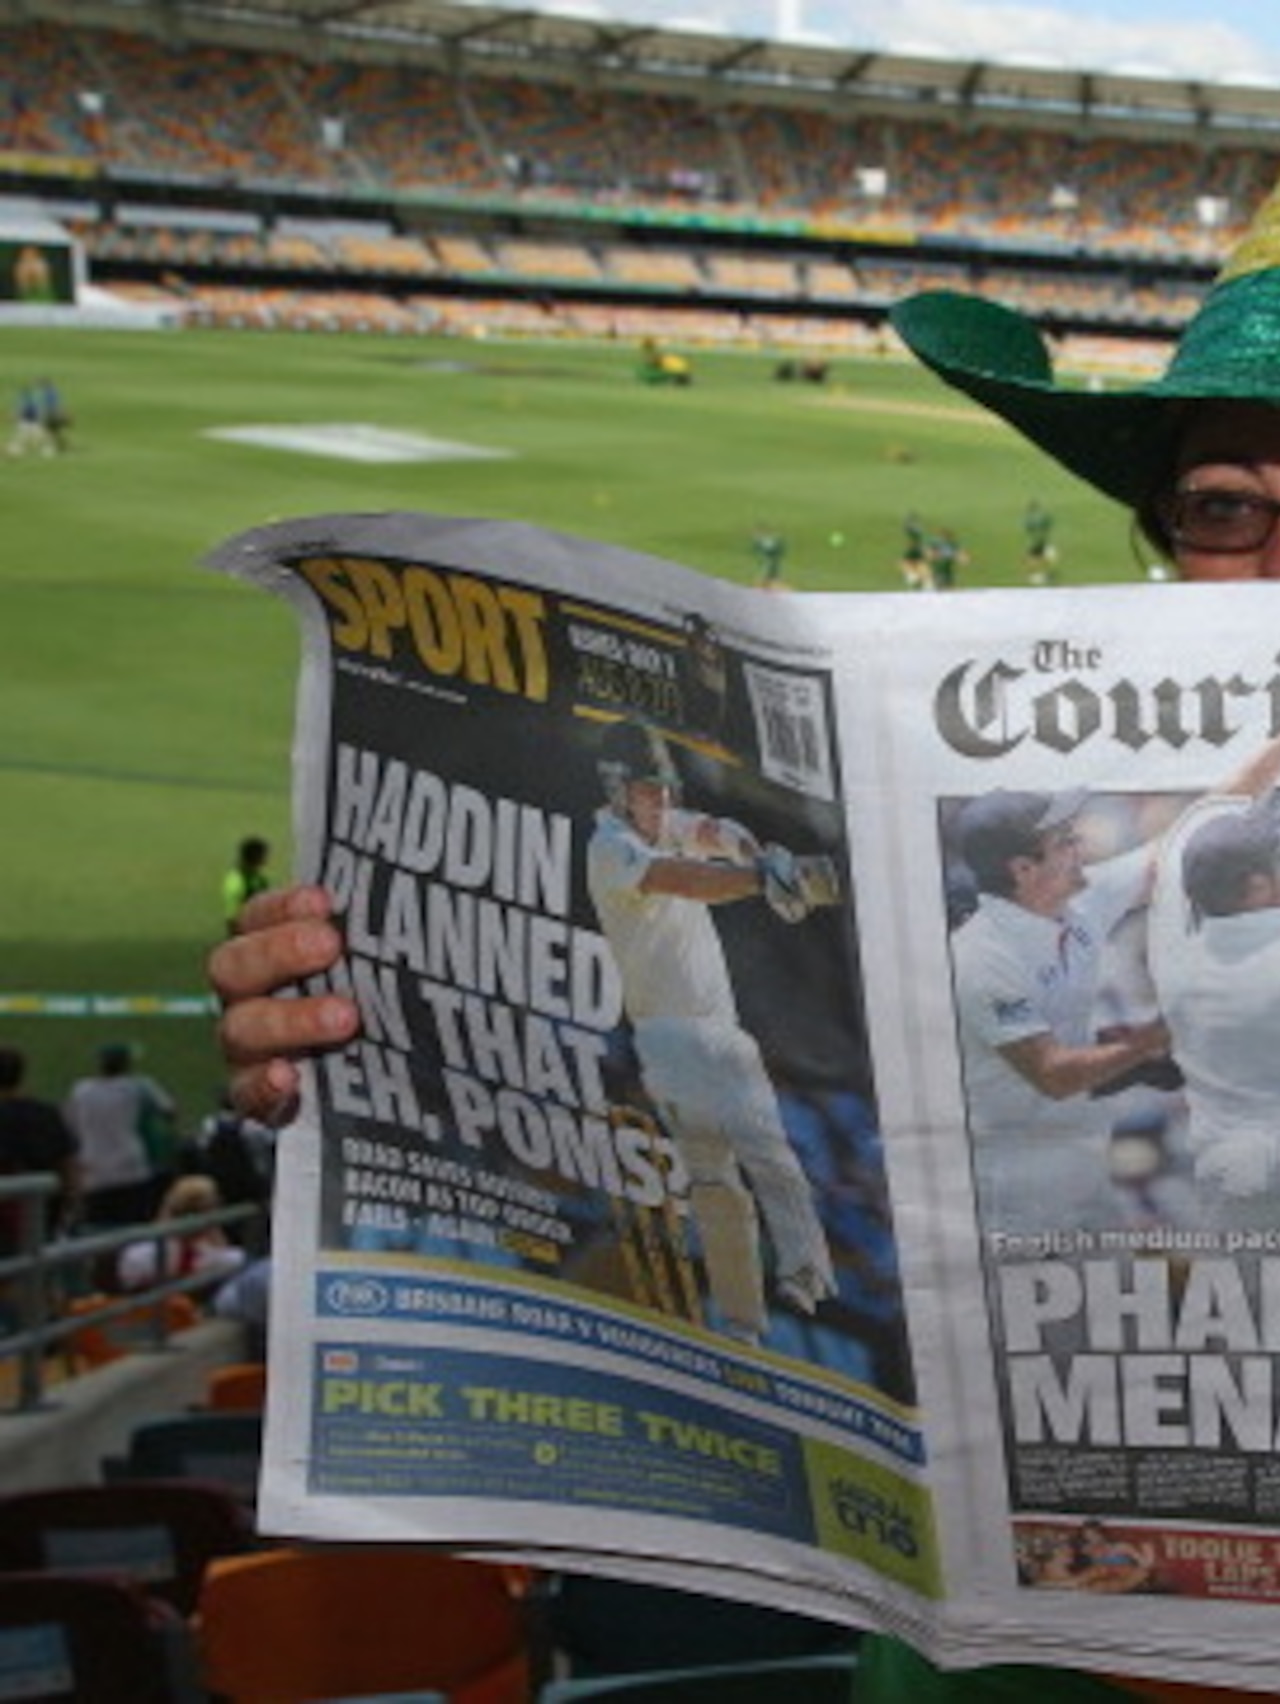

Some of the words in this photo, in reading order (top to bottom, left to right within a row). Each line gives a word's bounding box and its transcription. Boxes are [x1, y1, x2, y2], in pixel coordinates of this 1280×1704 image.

[302, 557, 548, 702] SPORT
[1033, 640, 1102, 673] The
[331, 743, 573, 918] HADDIN
[419, 979, 609, 1121] THAT
[445, 1067, 692, 1216] POMS?
[1100, 1227, 1221, 1248] medium
[322, 1379, 445, 1418] PICK
[458, 1387, 625, 1437] THREE
[637, 1411, 782, 1477] TWICE
